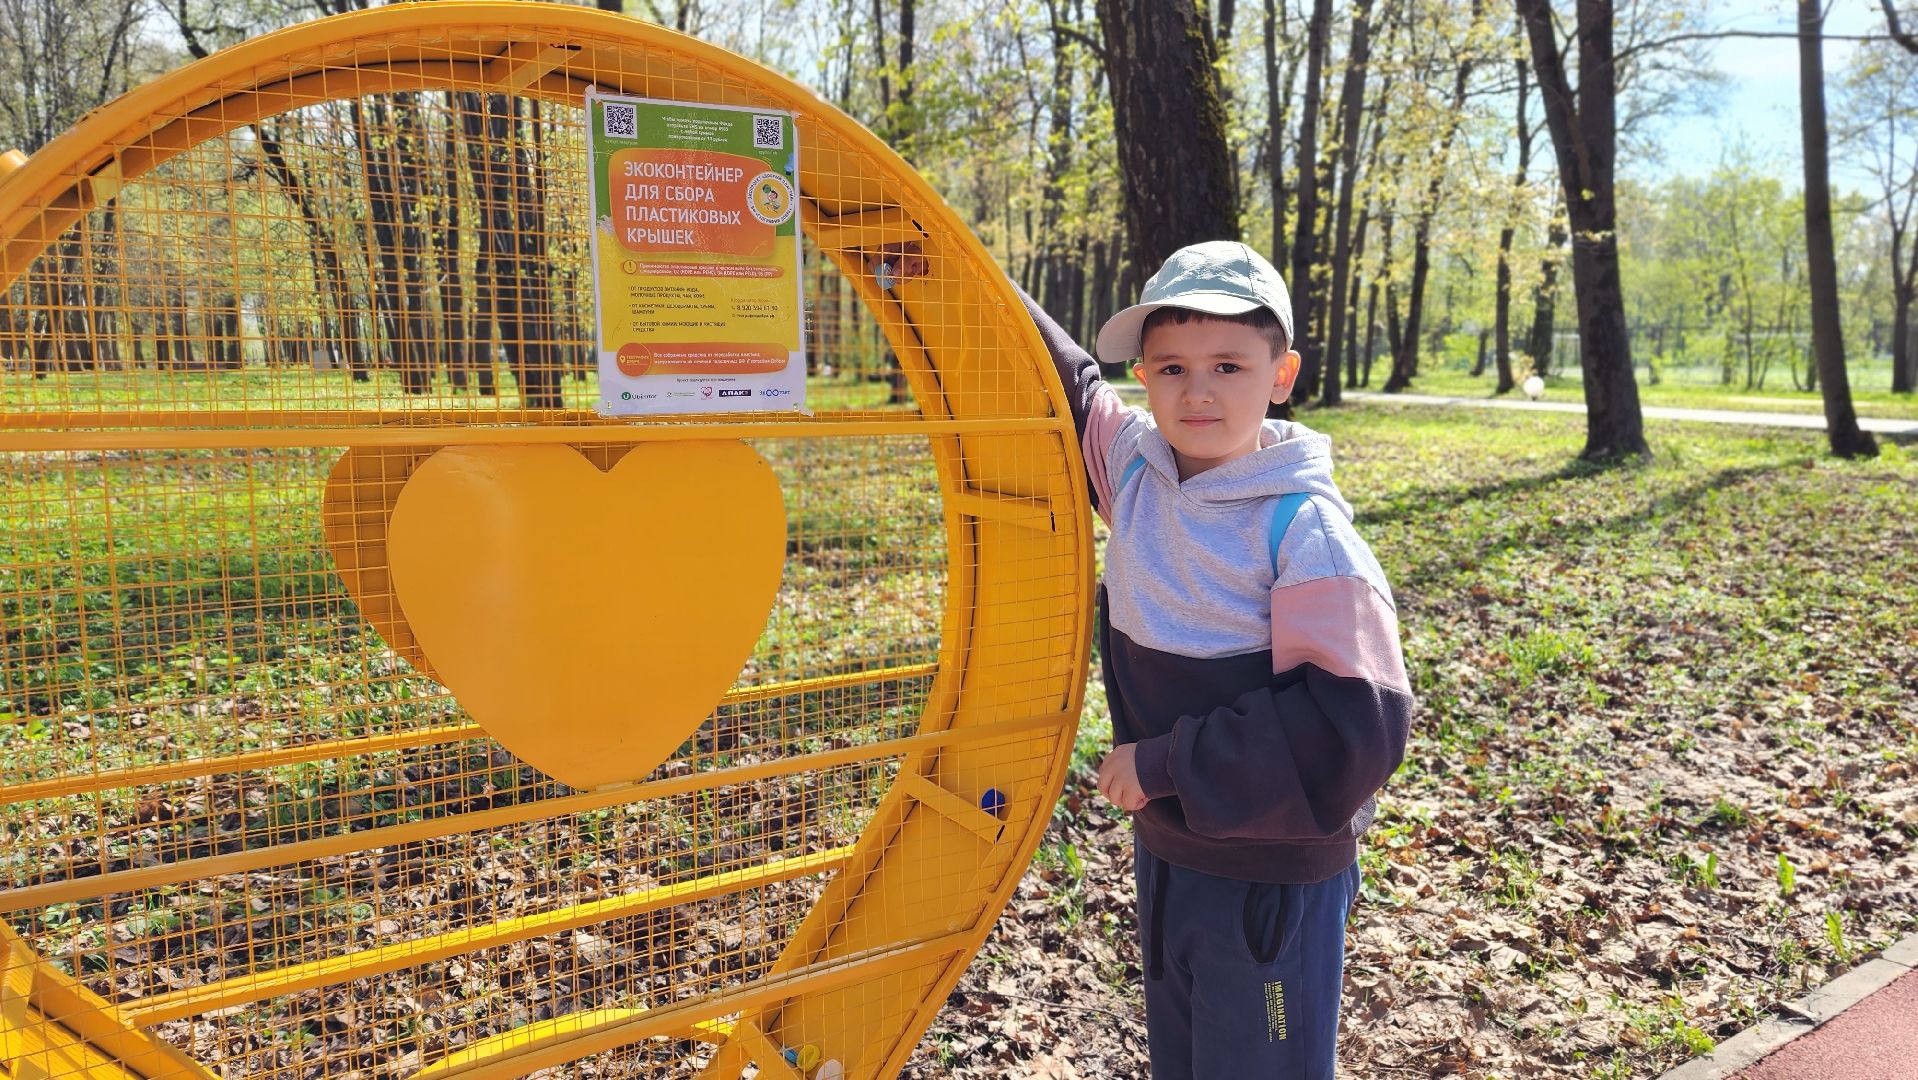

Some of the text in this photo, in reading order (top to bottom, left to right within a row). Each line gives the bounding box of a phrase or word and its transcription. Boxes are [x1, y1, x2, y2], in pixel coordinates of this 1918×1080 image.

[624, 160, 744, 183] ЭКОКОНТЕЙНЕР
[624, 184, 714, 202] ДЛЯ СБОРА
[626, 205, 741, 225] ПЛАСТИКОВЫХ
[627, 227, 694, 245] КРЫШЕК
[1274, 981, 1286, 1040] IMAGINATION
